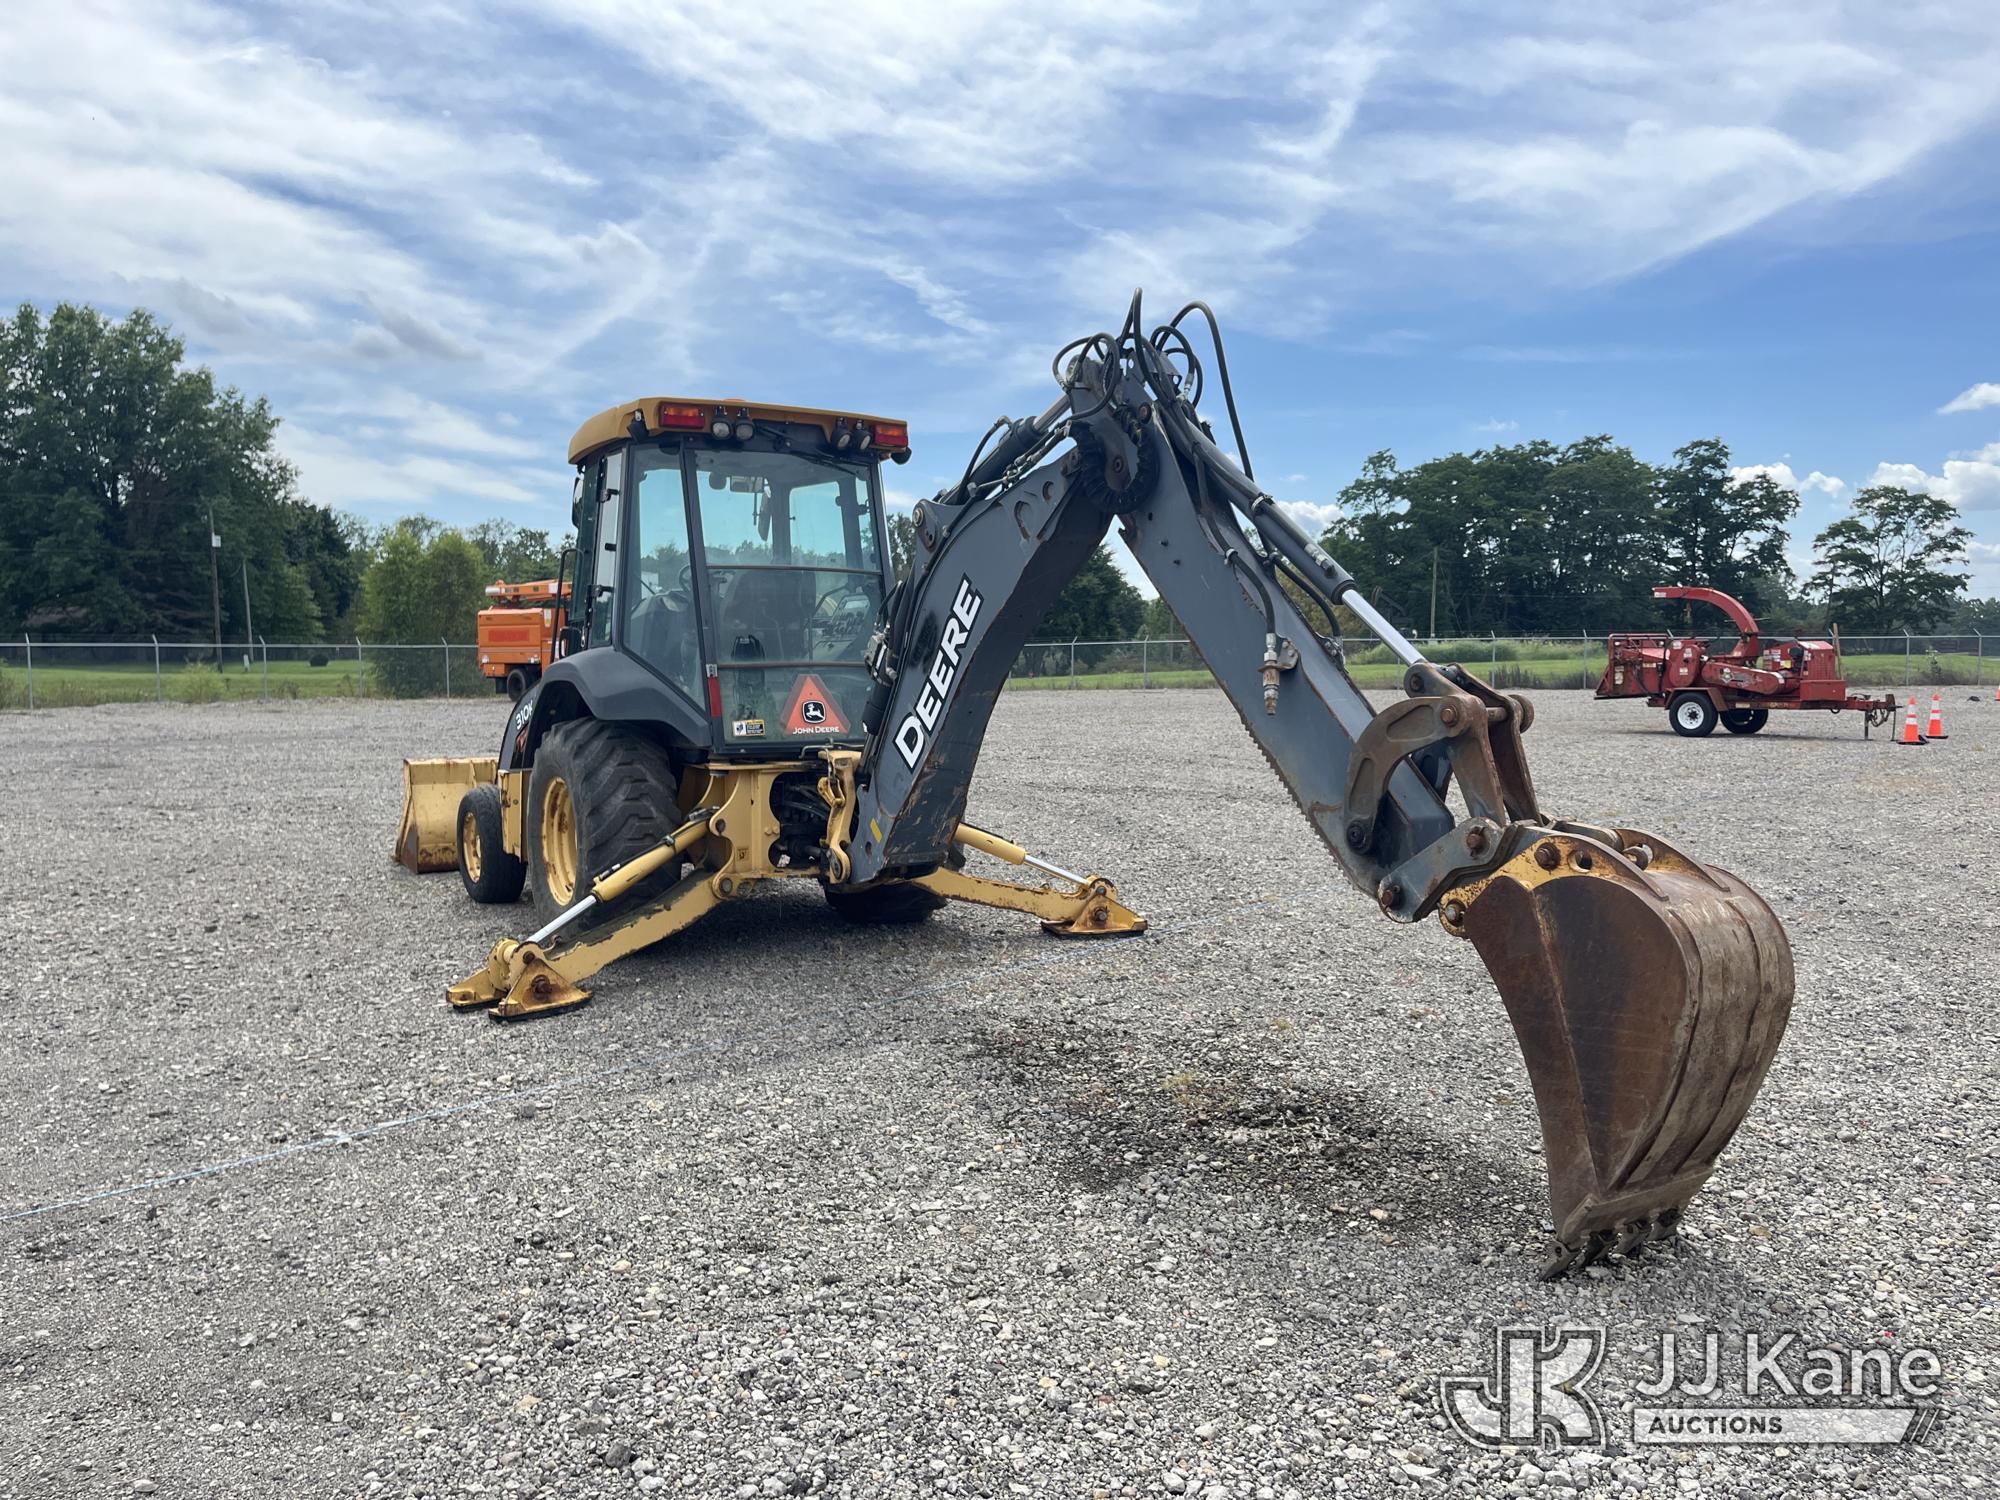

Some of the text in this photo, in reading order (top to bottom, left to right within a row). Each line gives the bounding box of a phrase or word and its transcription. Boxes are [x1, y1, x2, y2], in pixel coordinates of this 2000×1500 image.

[893, 576, 983, 771] DEERE
[792, 726, 840, 735] JOHN DEERE
